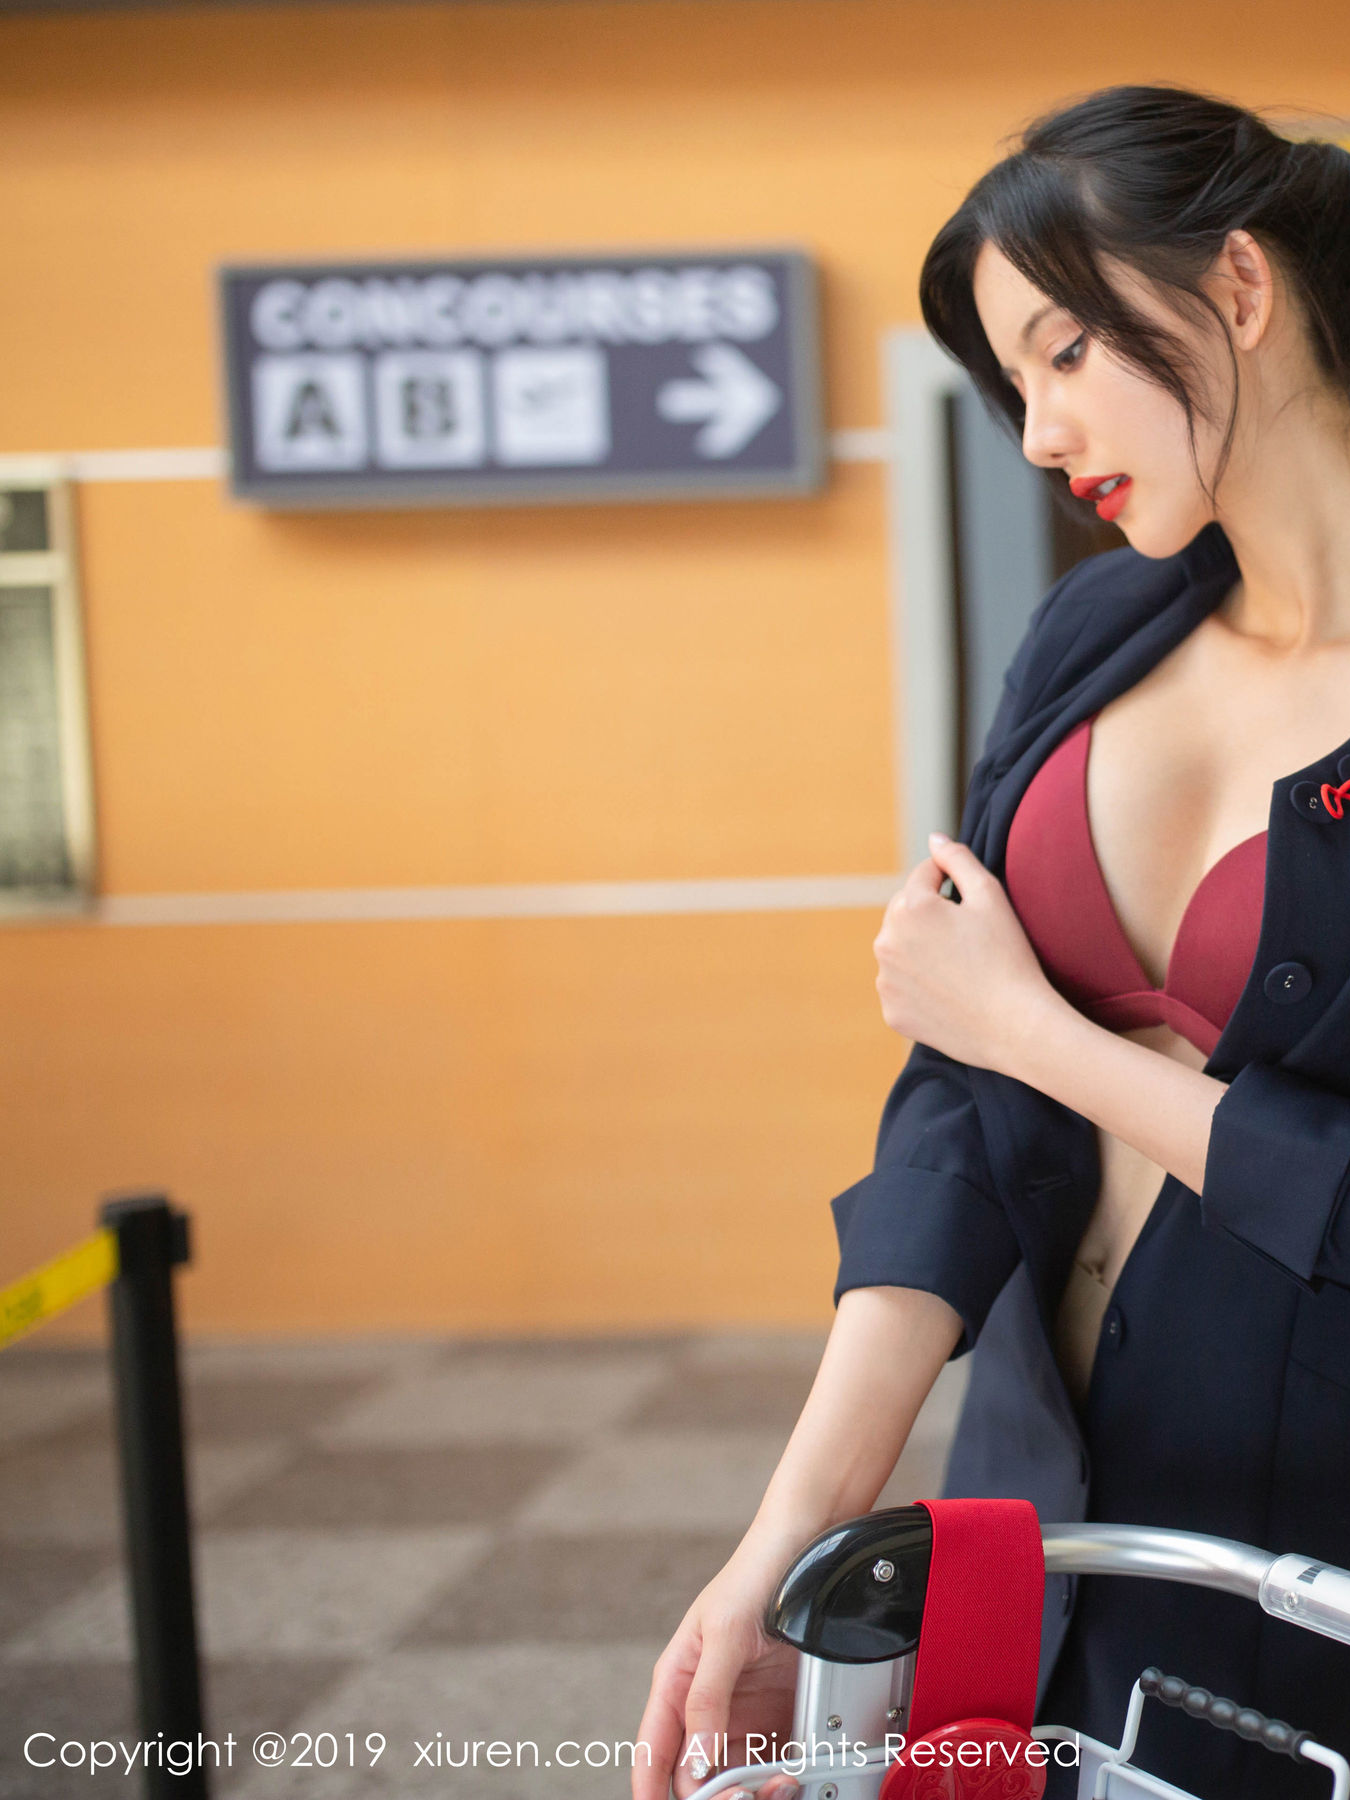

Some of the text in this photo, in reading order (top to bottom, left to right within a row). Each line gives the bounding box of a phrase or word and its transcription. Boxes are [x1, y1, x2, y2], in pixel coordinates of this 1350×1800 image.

[254, 268, 775, 346] CONCOURSES
[281, 372, 461, 445] A B
